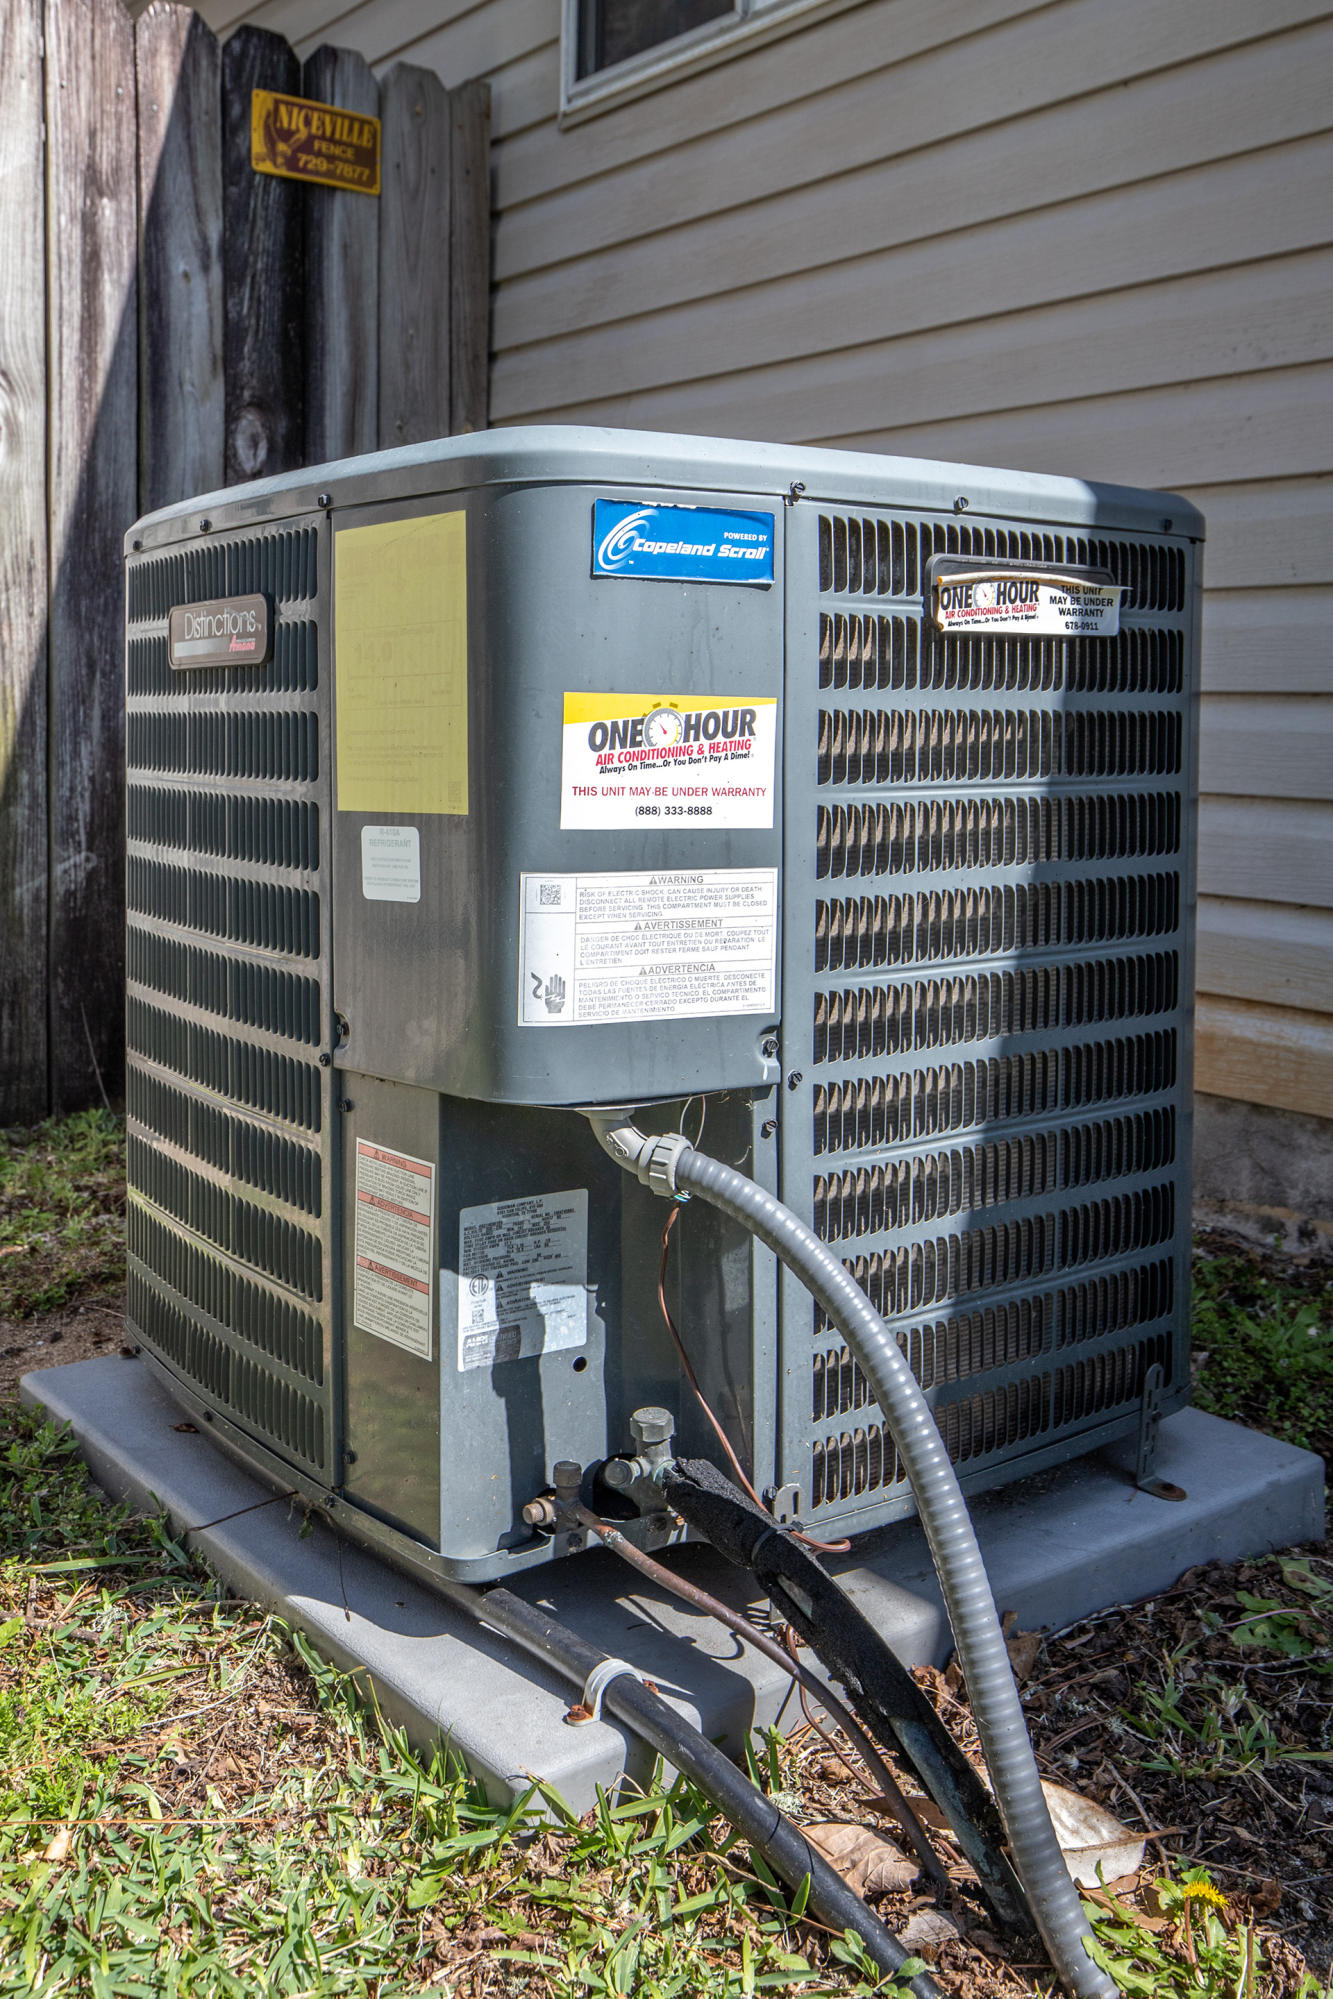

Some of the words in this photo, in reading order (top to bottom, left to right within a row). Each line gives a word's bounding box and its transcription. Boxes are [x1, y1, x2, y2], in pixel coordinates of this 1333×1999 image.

[277, 103, 374, 148] NICEVILLE
[314, 139, 355, 159] FENCE
[724, 532, 756, 541] POWERED
[758, 534, 767, 542] BY
[632, 538, 716, 556] Copeland
[717, 544, 766, 560] Scroll
[940, 583, 973, 611] ONE
[996, 580, 1040, 606] HOUR
[1061, 585, 1080, 595] THIS
[1082, 586, 1103, 595] UNIT
[1049, 595, 1068, 605] MAY
[1070, 596, 1082, 606] BE
[1083, 597, 1114, 607] UNDER
[945, 610, 956, 619] AIR
[957, 605, 1003, 619] CONDITIONING
[1004, 605, 1010, 614] &
[1011, 602, 1038, 614] HEATING
[1058, 607, 1104, 618] WARRANTY
[184, 607, 257, 640] Distinctions
[947, 619, 964, 627] Always
[1012, 614, 1020, 622] Pay
[1065, 622, 1099, 631] 678-0911
[229, 634, 256, 652] Amana
[588, 718, 645, 752] ONE
[682, 708, 757, 743] HOUR
[595, 753, 615, 767] AIR
[617, 744, 694, 764] CONDITIONING
[697, 743, 705, 755] &
[708, 739, 752, 754] HEATING
[599, 762, 626, 774] Always
[627, 762, 638, 771] On
[673, 757, 687, 766] You
[688, 755, 708, 765] Don't
[709, 754, 722, 764] Pay
[724, 753, 729, 761] A
[730, 751, 751, 760] Dime!
[572, 786, 598, 796] THIS
[601, 786, 626, 796] UNIT
[629, 786, 651, 796] MAY
[654, 786, 668, 796] BE
[671, 786, 708, 796] UNDER
[711, 786, 767, 797] WARRANTY
[634, 806, 661, 816] (888)
[664, 806, 713, 816] 333-8888
[658, 875, 704, 885] WARNING
[608, 889, 640, 897] ELECTRIC
[682, 887, 705, 895] CAUSE
[644, 919, 723, 930] AVERTISSEMENT
[621, 934, 640, 942] CHOC
[726, 929, 752, 937] COUPEZ
[590, 942, 623, 950] COURANT
[580, 949, 633, 958] COMPARTIMENT
[634, 948, 650, 956] DOIT
[648, 963, 716, 975] ADVERTENCIA
[620, 979, 648, 987] CHOQUE
[723, 972, 766, 981] DESCONECTE
[579, 988, 602, 996] TODAS
[618, 986, 648, 994] FUENTES
[712, 986, 767, 995] COMPARTIMENTO
[578, 1003, 596, 1011] DEBE
[598, 1001, 644, 1009] PERMANECER
[645, 999, 677, 1007] CERRADO
[679, 996, 709, 1004] EXCEPTO
[710, 994, 740, 1003] DURANTE
[578, 1010, 610, 1018] SERVICIO
[381, 1153, 407, 1168] WARNING
[375, 1199, 414, 1219] ADVERTENCIA
